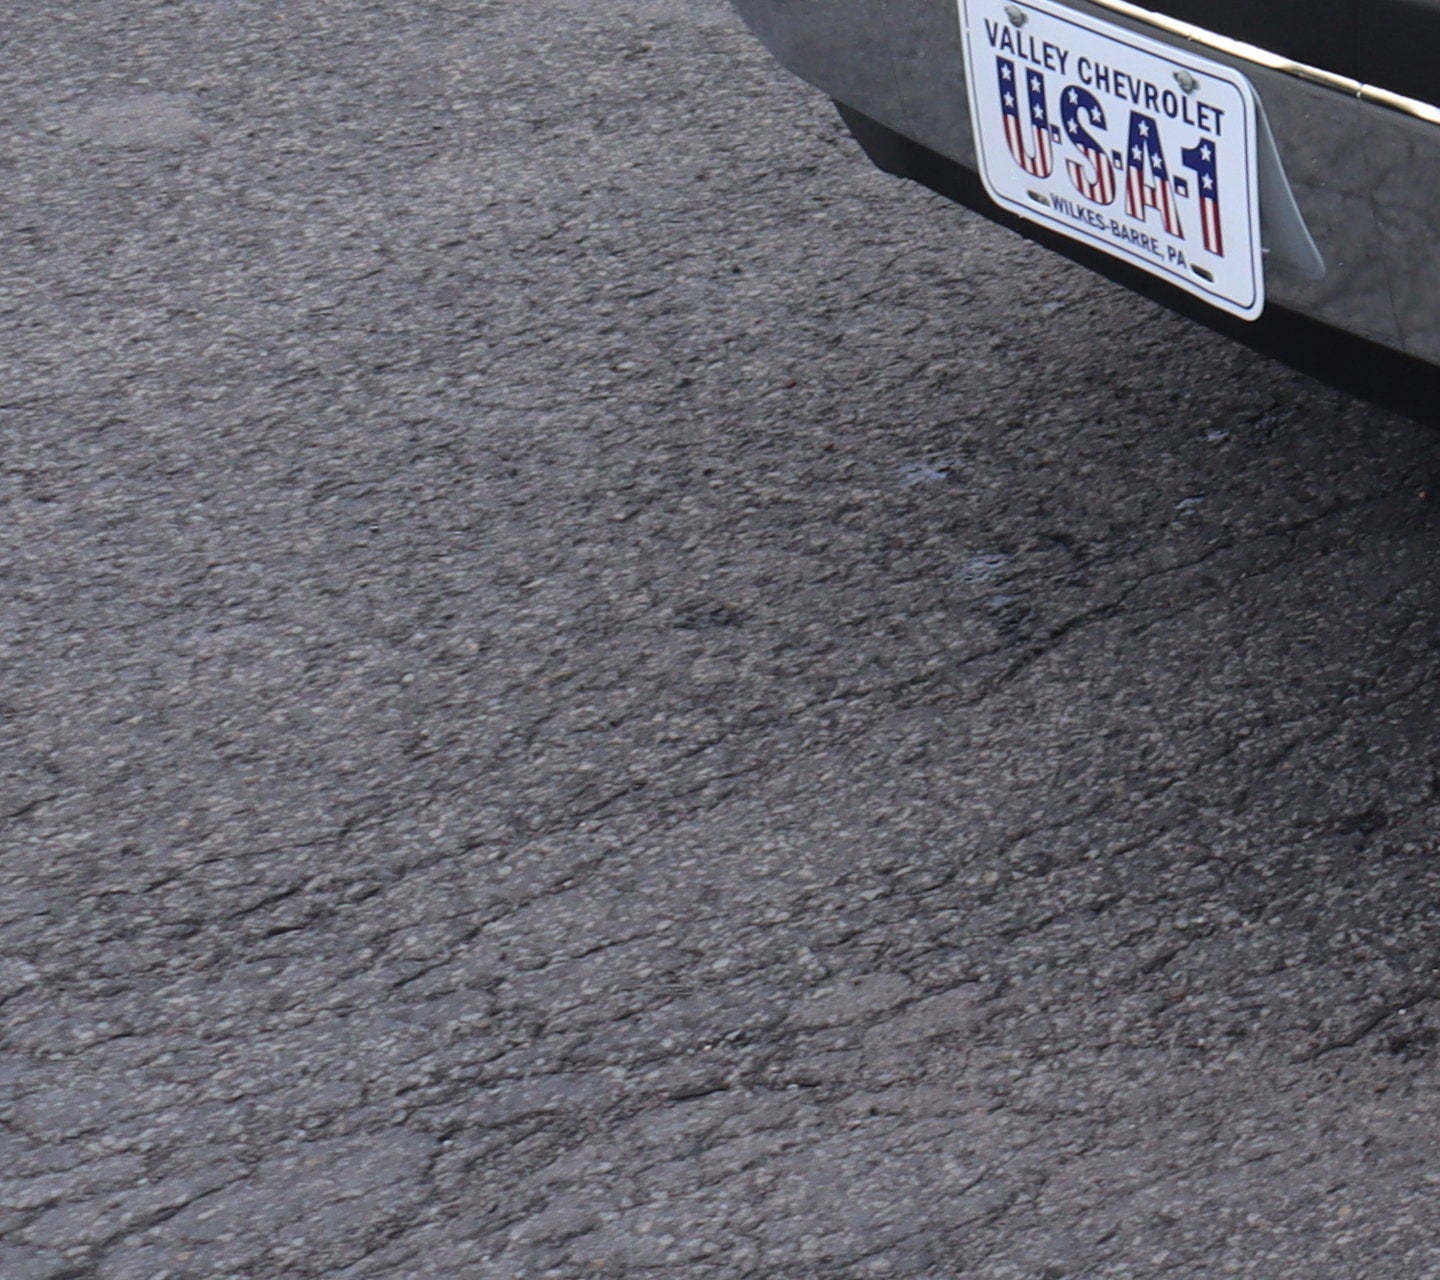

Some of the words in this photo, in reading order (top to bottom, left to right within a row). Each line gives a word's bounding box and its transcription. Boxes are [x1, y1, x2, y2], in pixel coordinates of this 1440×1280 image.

[984, 18, 1069, 76] VALLEY
[1077, 57, 1226, 137] CHEVROLET
[1050, 193, 1165, 262] WILKES-BARRE,
[1168, 244, 1189, 270] PA
